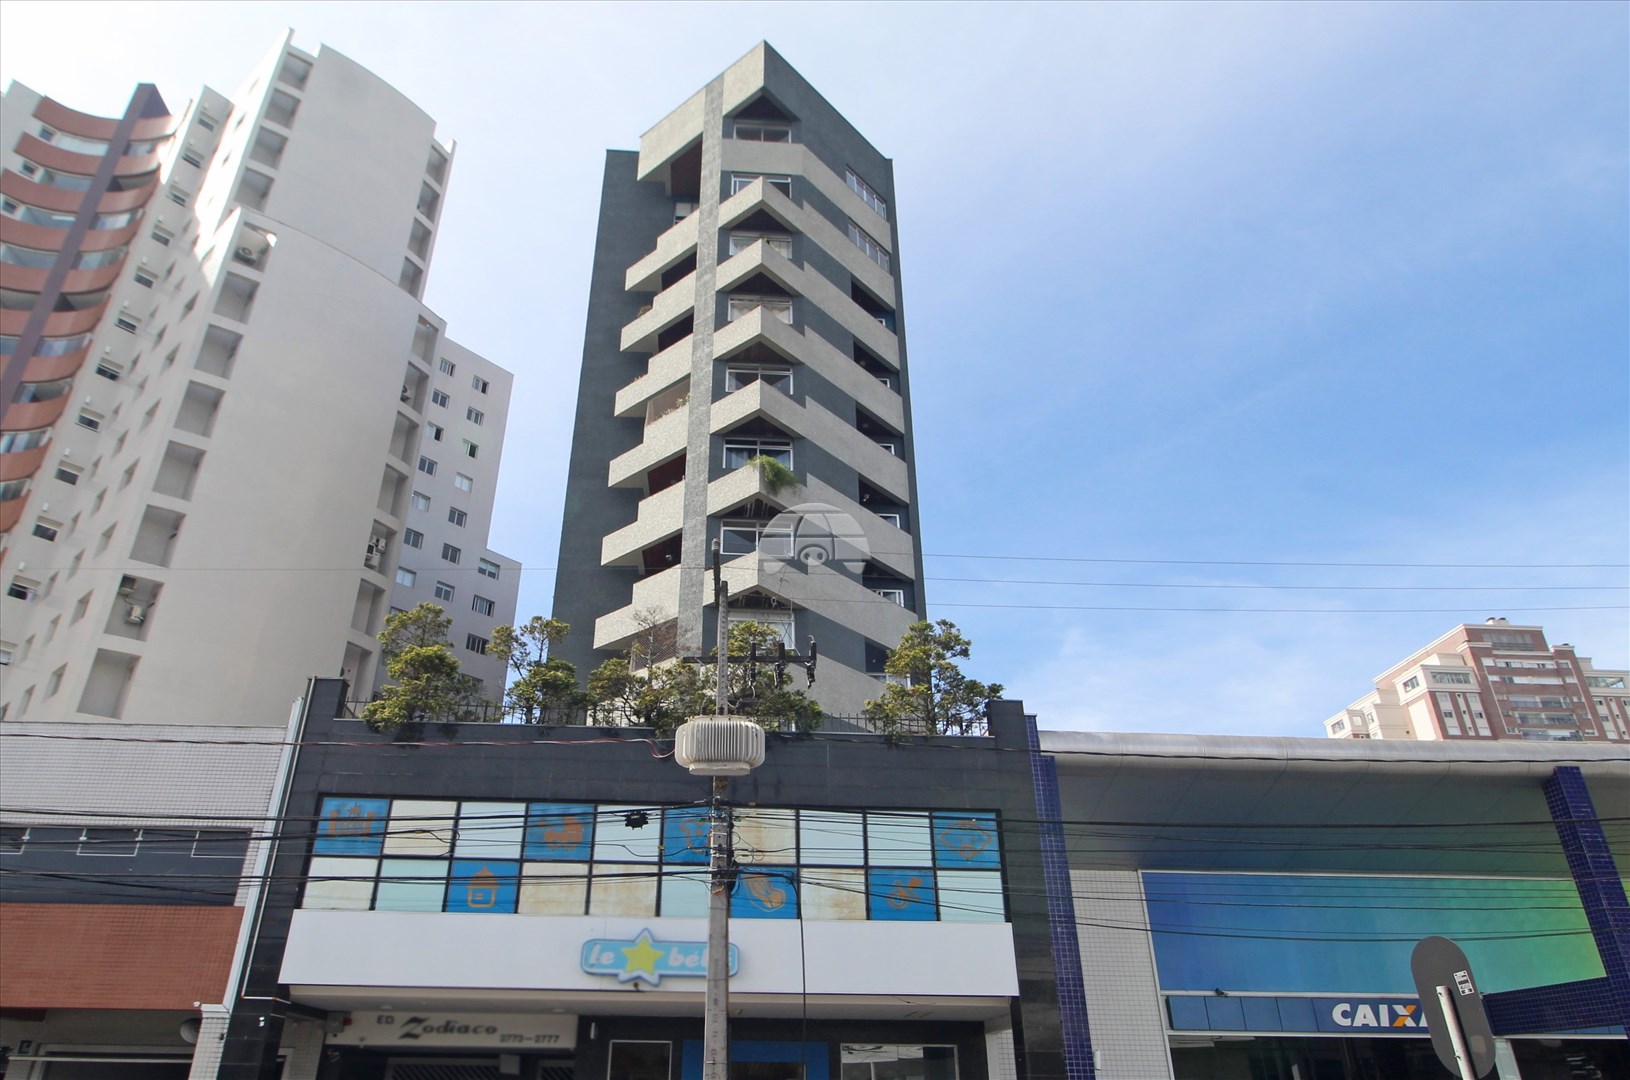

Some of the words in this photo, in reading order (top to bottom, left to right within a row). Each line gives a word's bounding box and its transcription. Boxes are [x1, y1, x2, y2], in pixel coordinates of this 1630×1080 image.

[589, 944, 616, 965] le
[668, 947, 732, 968] bé
[376, 1015, 395, 1024] ED
